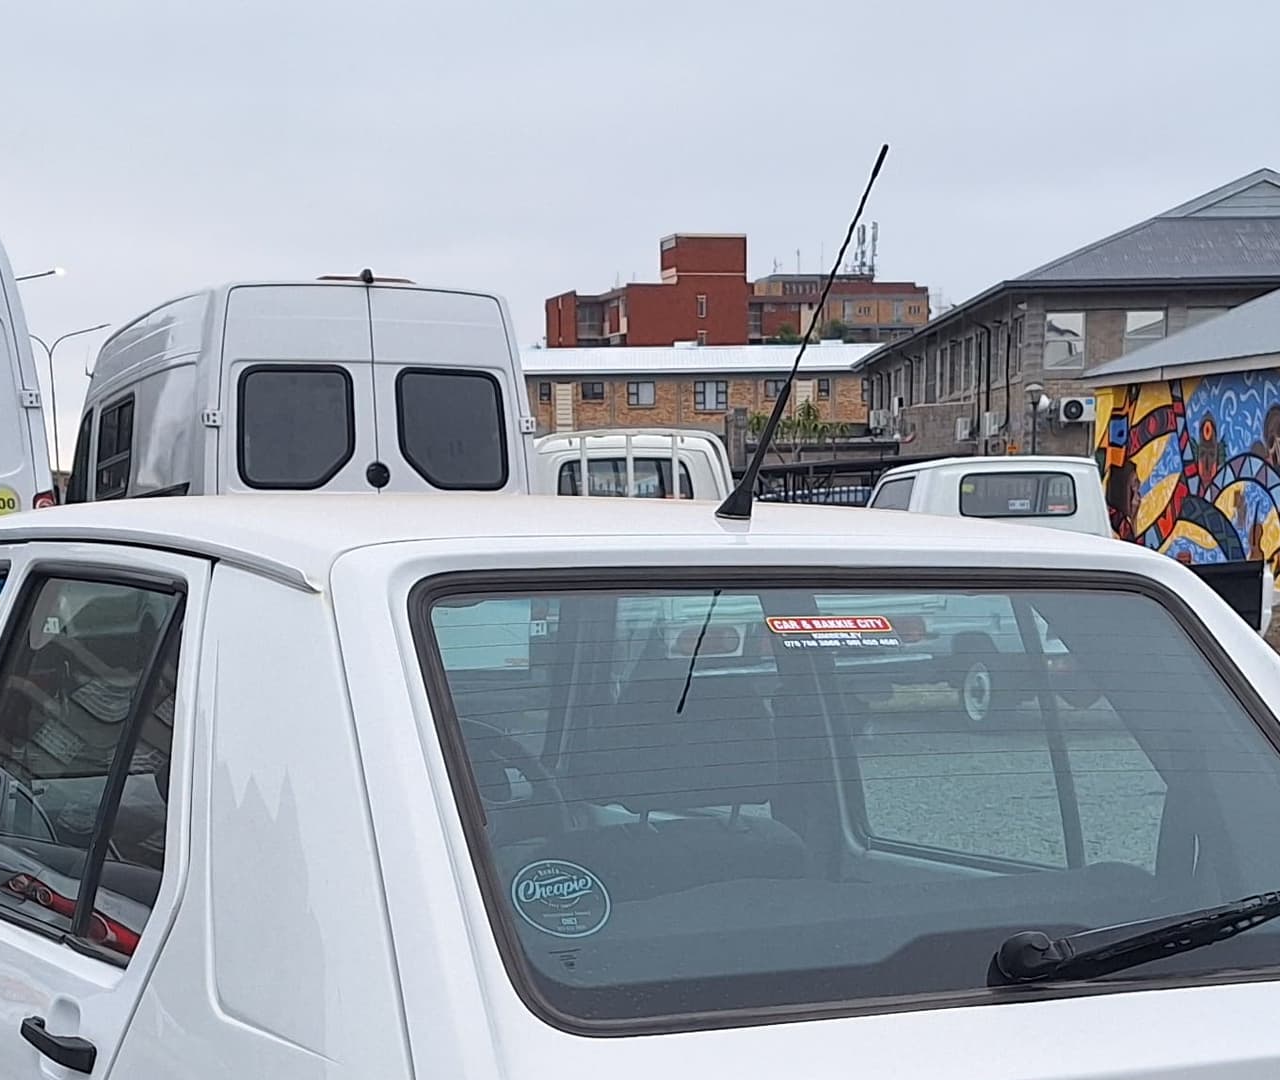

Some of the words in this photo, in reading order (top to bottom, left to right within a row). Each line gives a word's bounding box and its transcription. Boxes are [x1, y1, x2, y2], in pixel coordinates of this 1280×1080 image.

[772, 620, 798, 630] CAR
[800, 619, 813, 630] &
[812, 618, 856, 629] BAKKIE
[857, 618, 884, 629] CITY
[518, 875, 593, 902] Cheapie
